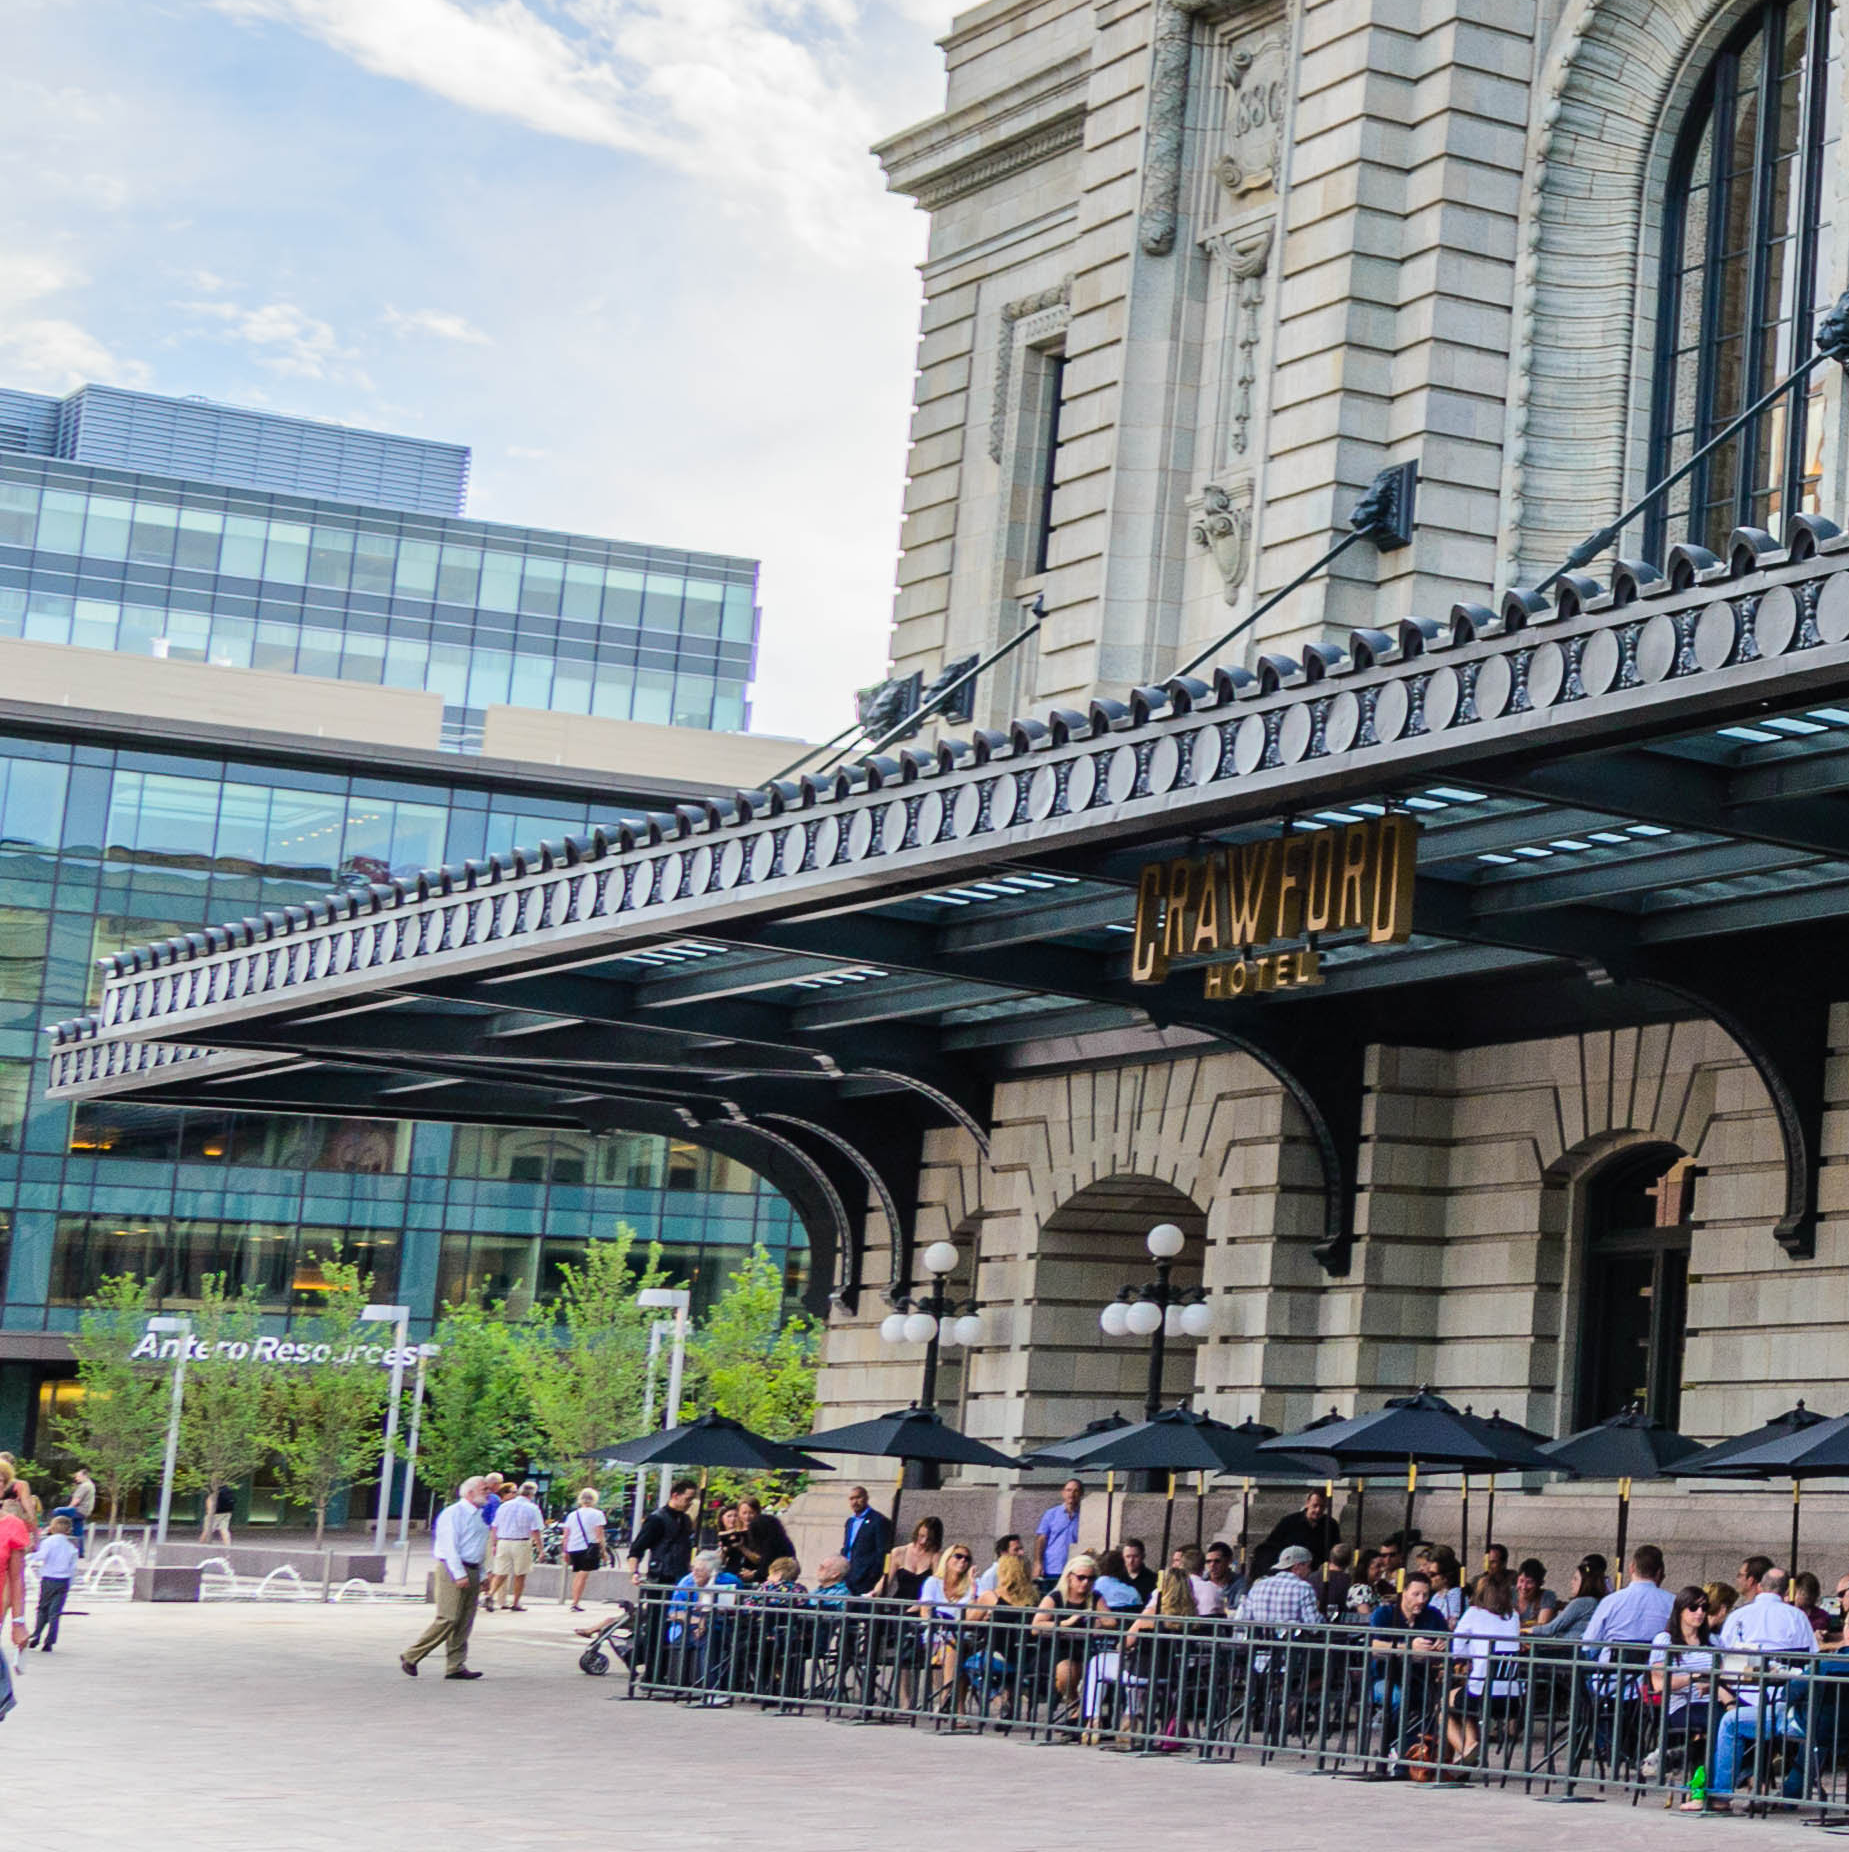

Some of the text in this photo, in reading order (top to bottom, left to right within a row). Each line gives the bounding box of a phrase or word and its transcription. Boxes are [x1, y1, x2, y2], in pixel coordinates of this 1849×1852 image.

[1131, 813, 1419, 984] CRAWFORD
[1205, 952, 1323, 998] HOTEL
[131, 1332, 248, 1361] Antero
